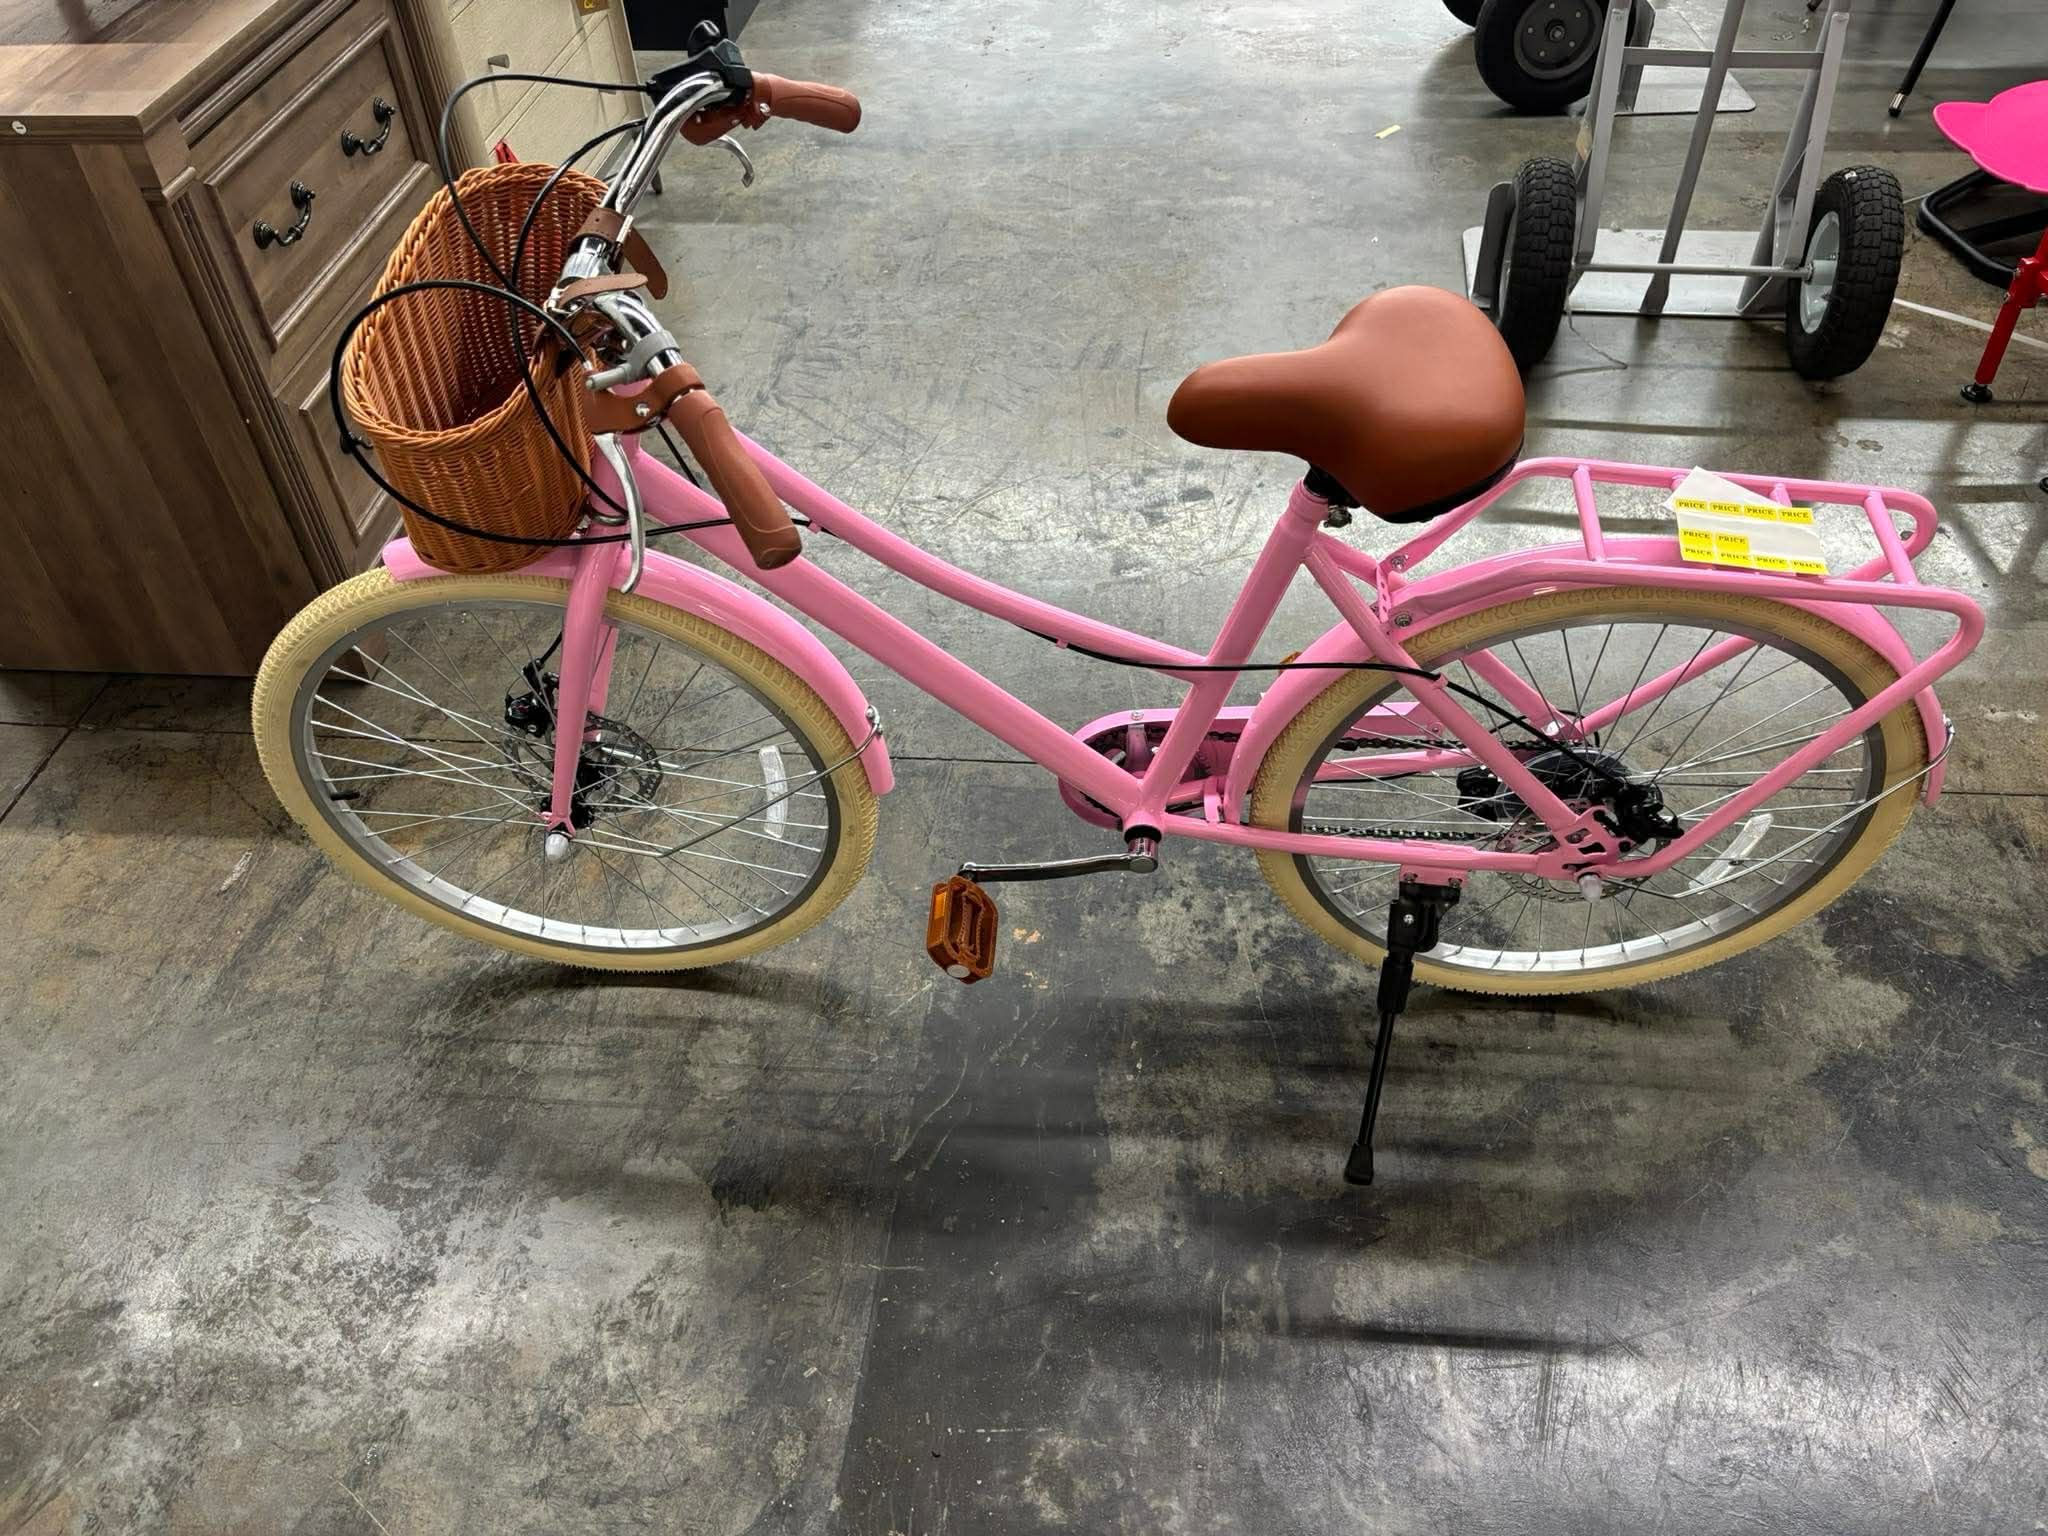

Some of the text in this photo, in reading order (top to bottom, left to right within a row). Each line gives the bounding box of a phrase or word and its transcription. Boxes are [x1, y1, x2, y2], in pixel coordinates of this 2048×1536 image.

[1679, 501, 1705, 509] PRICE
[1712, 504, 1739, 513] PRICE
[1746, 507, 1774, 515] PRICE
[1683, 531, 1745, 544] PRICE PRICE
[1685, 548, 1711, 556] PRICE
[1757, 556, 1785, 565] PRICE
[1793, 561, 1822, 569] PRICE
